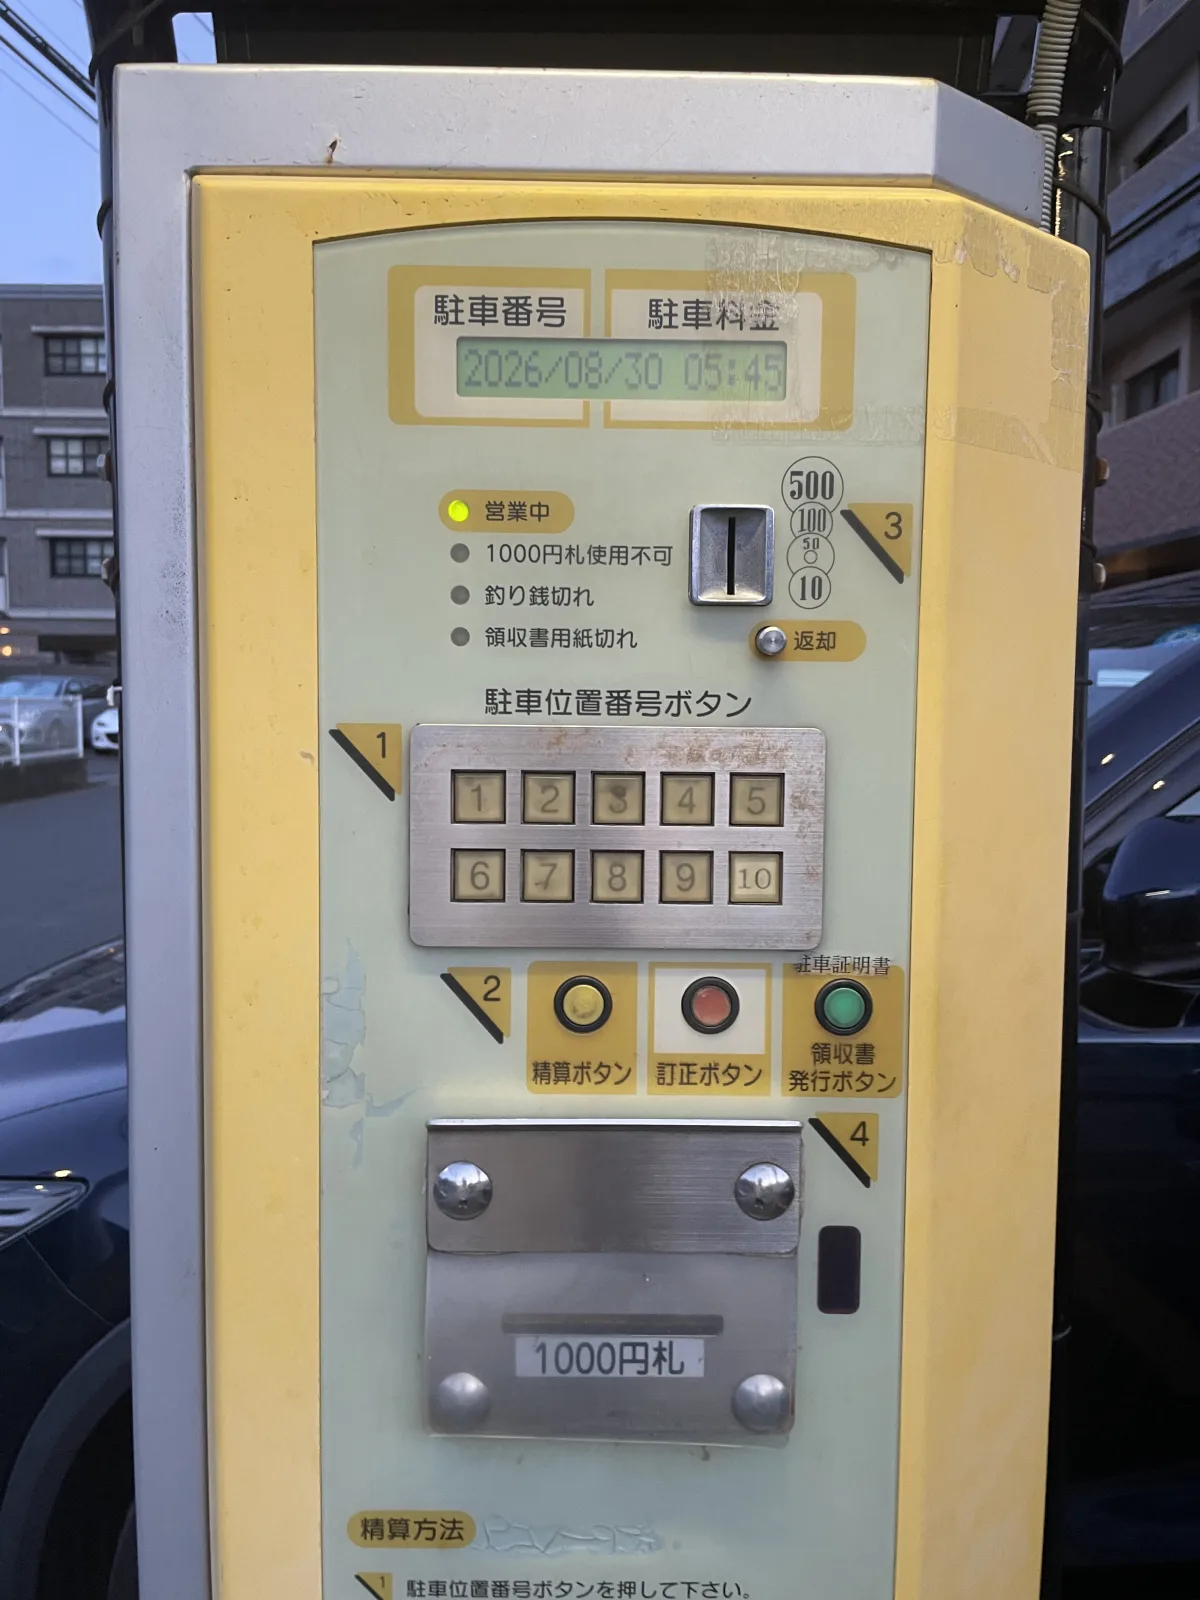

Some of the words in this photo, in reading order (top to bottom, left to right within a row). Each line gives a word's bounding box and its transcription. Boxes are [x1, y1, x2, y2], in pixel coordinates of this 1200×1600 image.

[433, 294, 567, 328] 駐車番号
[648, 299, 780, 331] 駐車料金
[464, 348, 663, 390] 2026/08/30
[684, 351, 783, 393] 05:45
[788, 469, 835, 502] 500
[485, 501, 550, 522] 営業中
[797, 507, 827, 534] 100
[884, 511, 903, 540] 3
[485, 543, 673, 567] 1000円札使用不可
[803, 537, 820, 551] 50
[484, 585, 595, 607] 釣り銭切れ
[799, 575, 823, 602] 10
[485, 627, 638, 650] 領収書用紙切れ
[793, 630, 836, 651] 返却
[485, 689, 753, 717] 駐車位置番号ボタン
[376, 731, 387, 758] 1
[471, 784, 483, 811] 1
[539, 784, 561, 814] 2
[607, 785, 629, 815] 3
[676, 786, 697, 815] 4
[746, 785, 767, 816] 5
[469, 860, 492, 891] 6
[536, 862, 559, 893] 7
[608, 862, 628, 893] 8
[675, 862, 697, 893] 9
[736, 867, 773, 891] 10
[482, 974, 502, 1002] 2
[810, 1043, 876, 1066] 領収書
[531, 1061, 633, 1087] 精算ボタン
[656, 1062, 763, 1088] 訂正ボタン
[788, 1069, 897, 1094] 発行ボタン
[849, 1121, 871, 1147] 4
[535, 1341, 685, 1377] 1000円札
[359, 1517, 465, 1543] 精算方法
[405, 1578, 753, 1600] 駐車位置番号ボタンを押して下さい。
